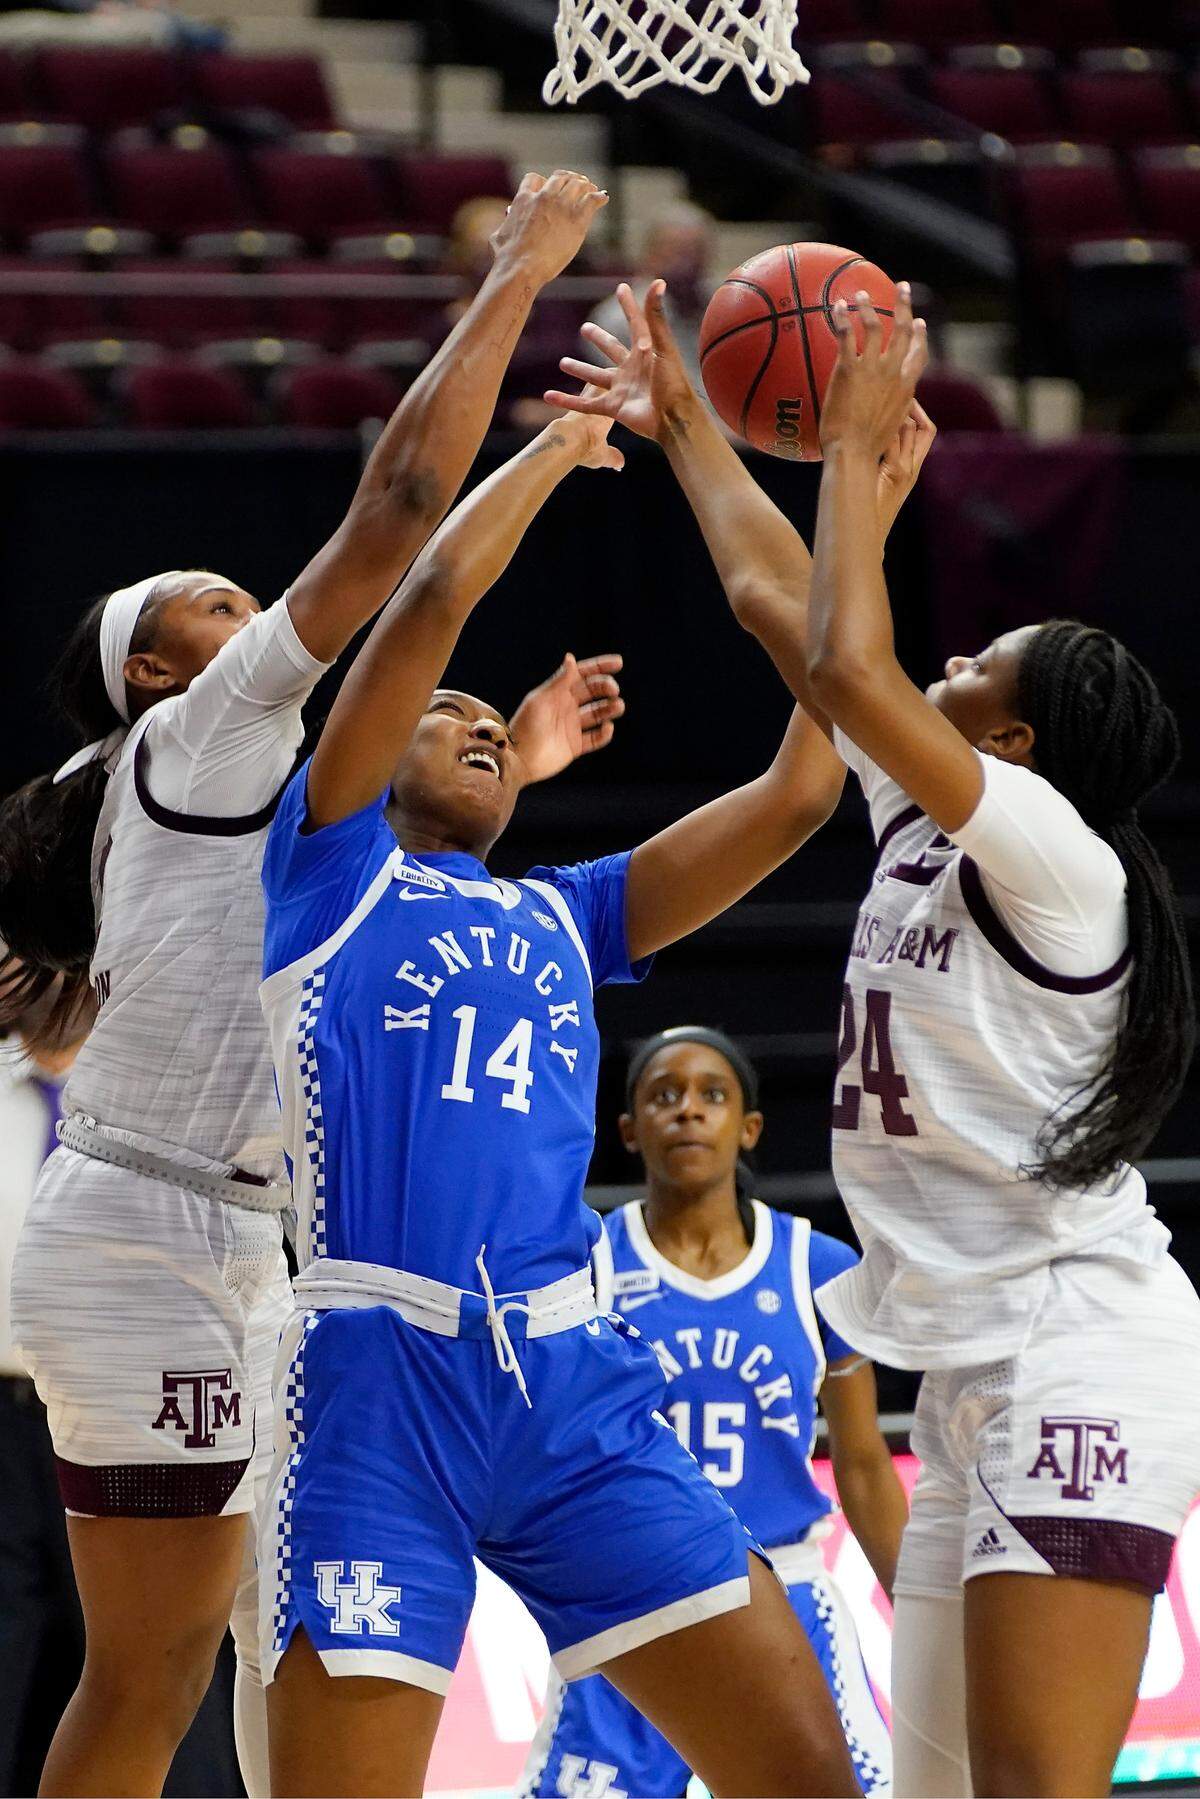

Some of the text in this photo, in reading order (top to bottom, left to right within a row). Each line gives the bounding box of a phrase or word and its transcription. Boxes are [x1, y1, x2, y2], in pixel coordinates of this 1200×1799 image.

[775, 398, 803, 457] son
[877, 924, 960, 972] A&M
[384, 926, 580, 1074] KENTUCKY
[441, 1004, 534, 1114] 14
[832, 982, 918, 1136] 24
[652, 1327, 800, 1438] NTUCKY
[667, 1401, 746, 1487] 15
[313, 1561, 401, 1637] UK
[556, 1753, 628, 1798] U
